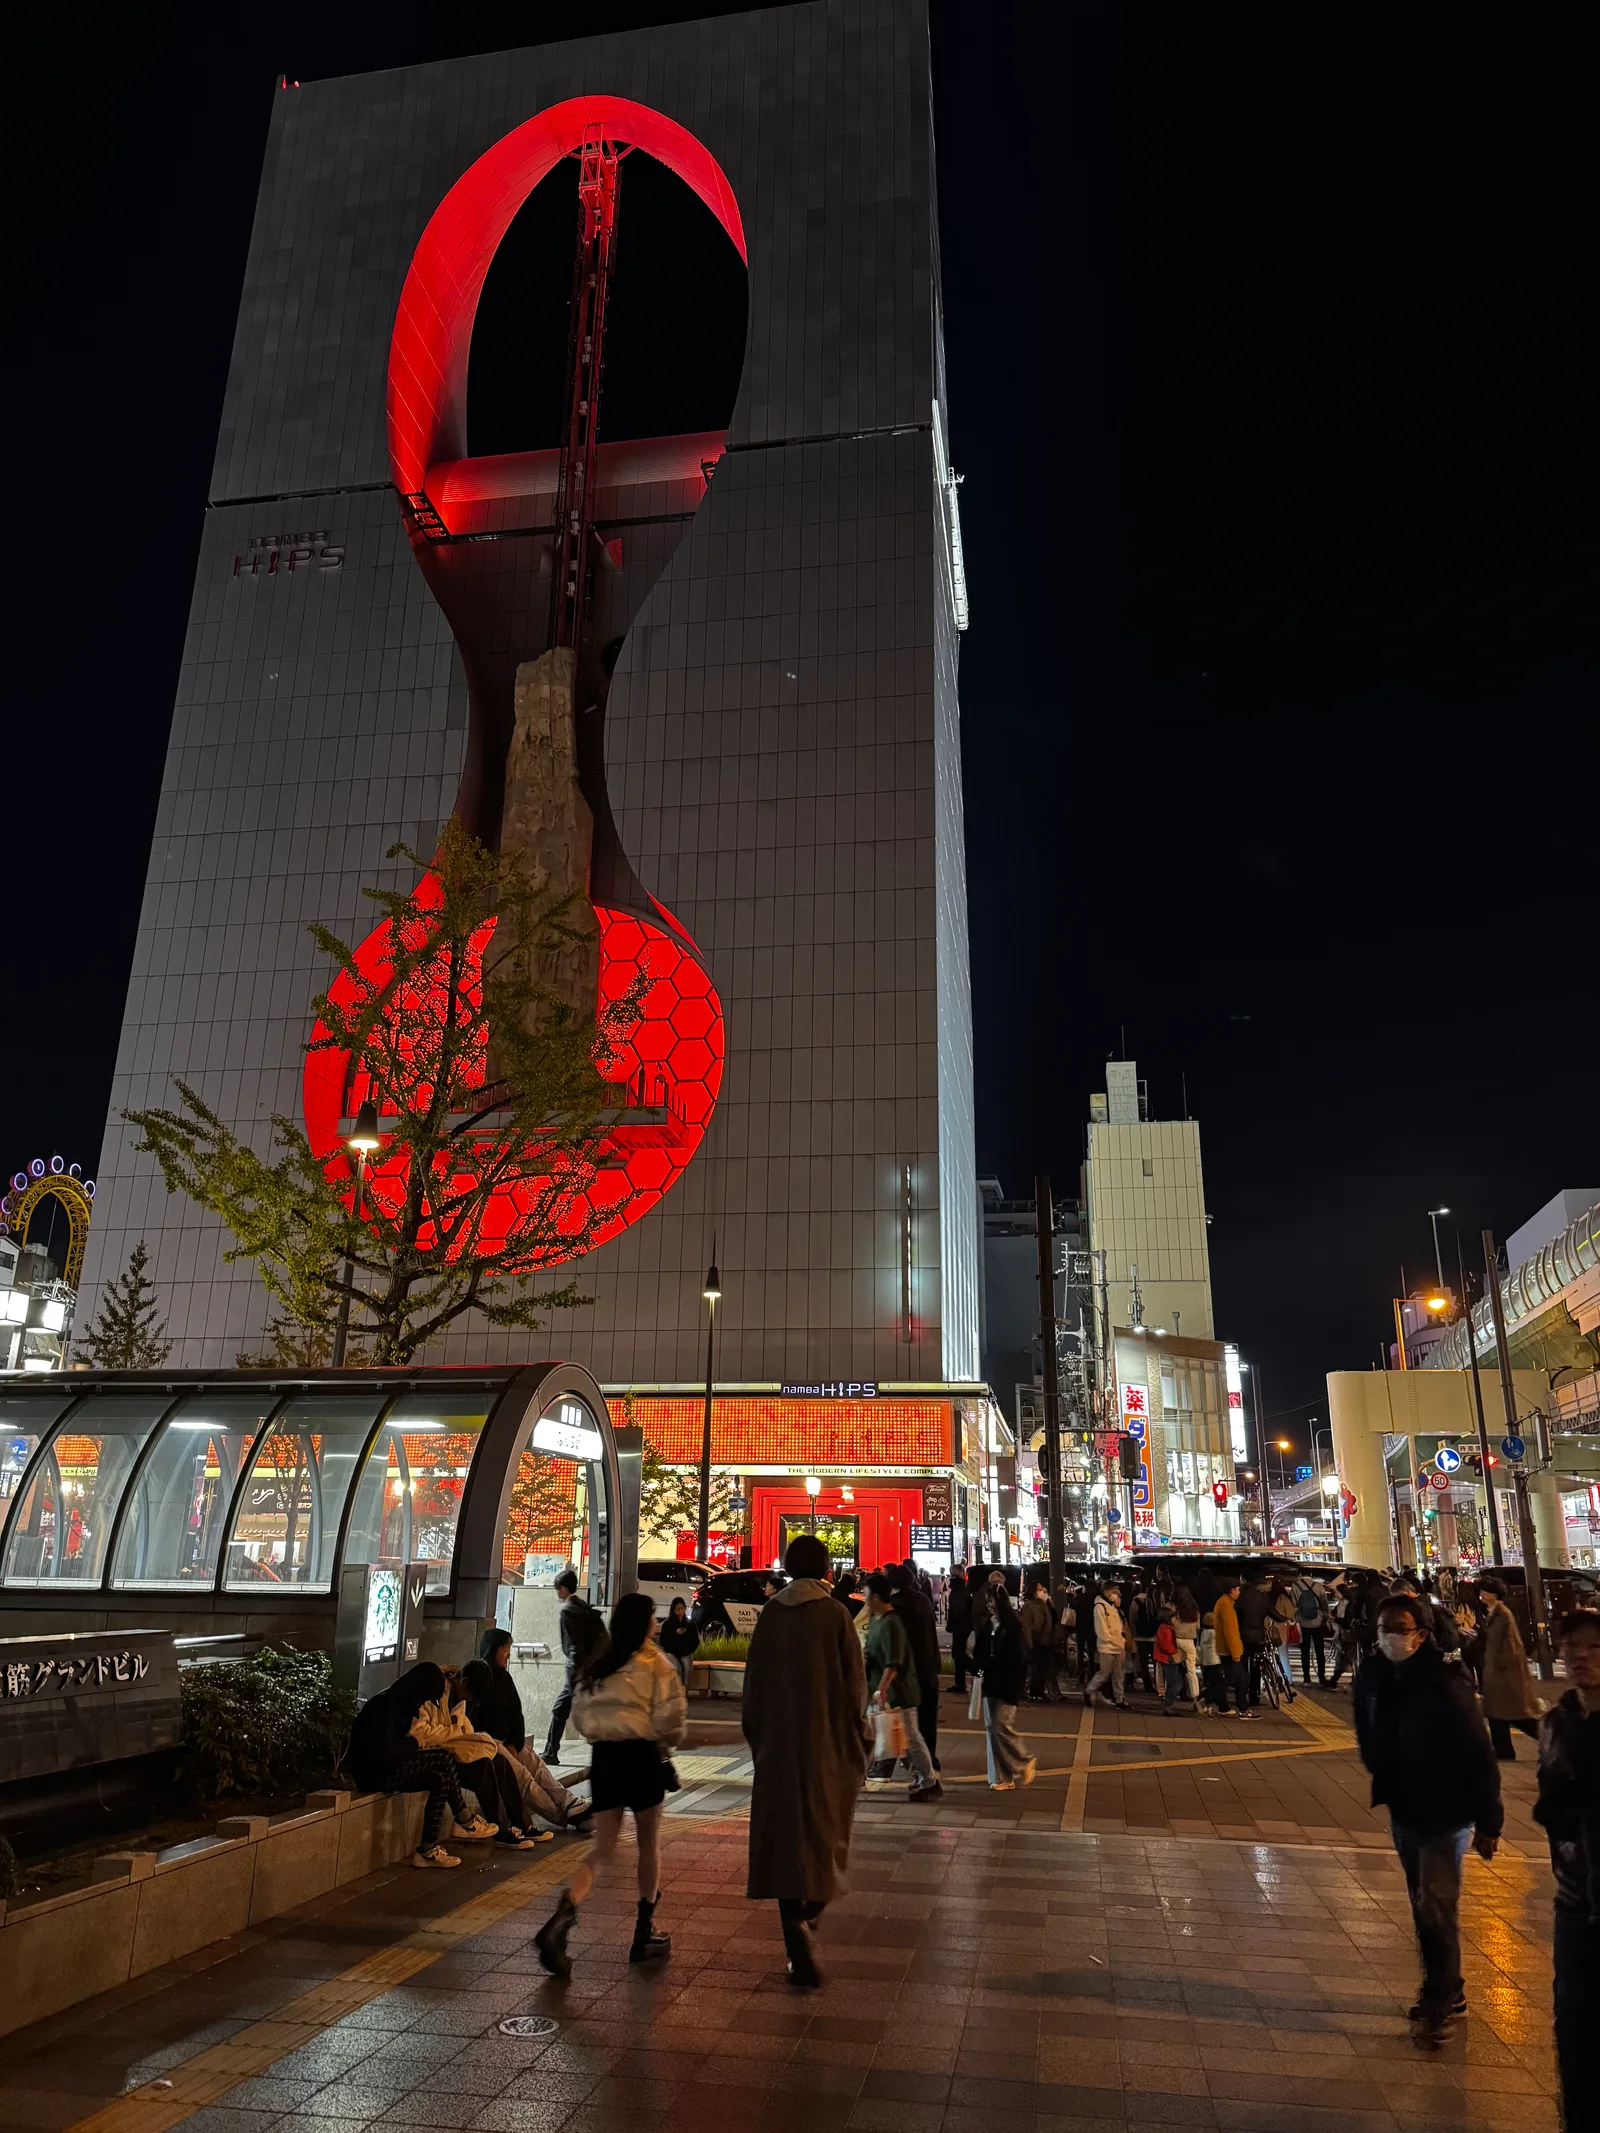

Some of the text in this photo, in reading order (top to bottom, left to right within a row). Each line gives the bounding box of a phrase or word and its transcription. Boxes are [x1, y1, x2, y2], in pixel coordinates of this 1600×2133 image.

[821, 1382, 876, 1397] HIPS
[1126, 1386, 1146, 1412] 薬
[1434, 1476, 1446, 1486] 50
[928, 1509, 937, 1521] P
[0, 1651, 150, 1698] 筋グランドビル
